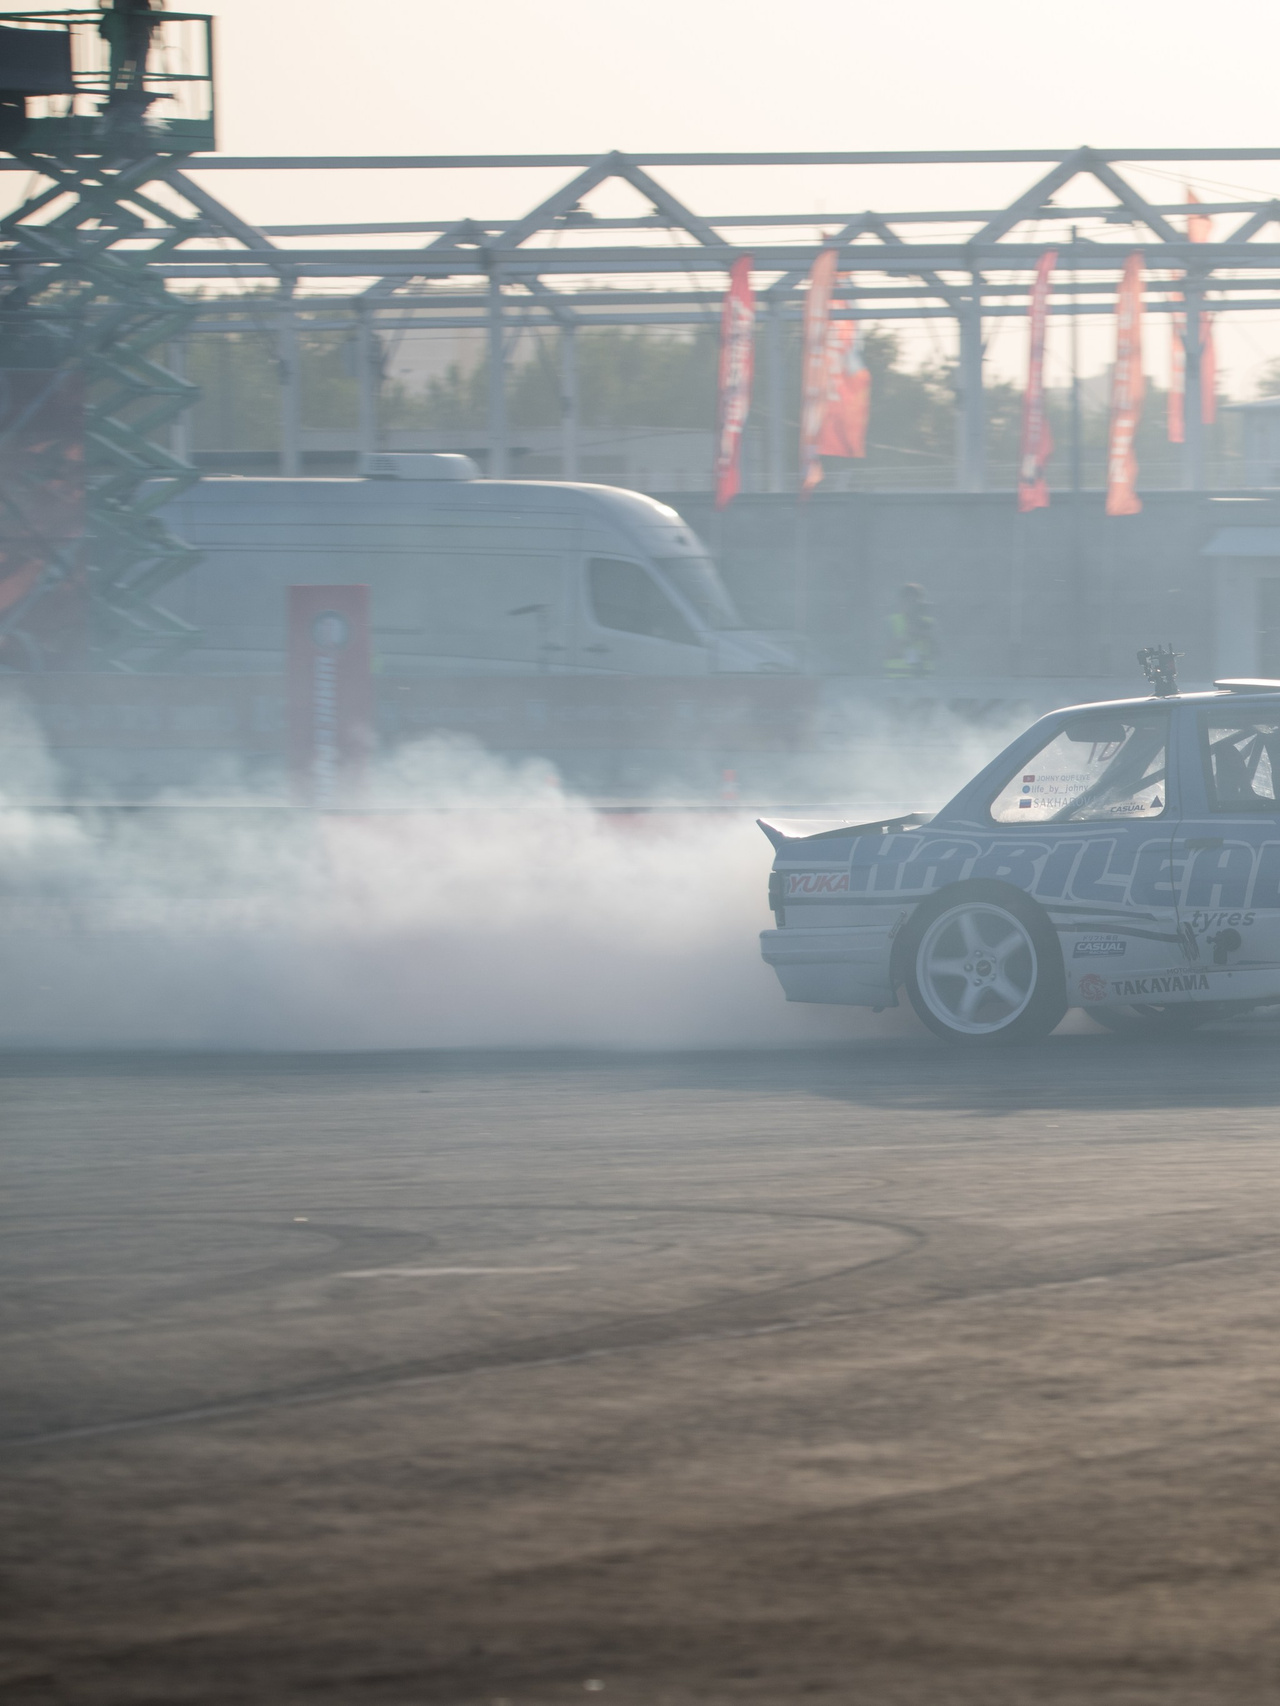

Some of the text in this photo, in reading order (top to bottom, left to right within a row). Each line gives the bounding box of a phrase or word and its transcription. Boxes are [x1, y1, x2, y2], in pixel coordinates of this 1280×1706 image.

[1110, 805, 1146, 813] CASUAL
[789, 873, 850, 893] YUKA
[1190, 909, 1255, 932] tyres
[1076, 942, 1124, 951] CASUAL
[1111, 974, 1210, 996] TAKAYAMA
